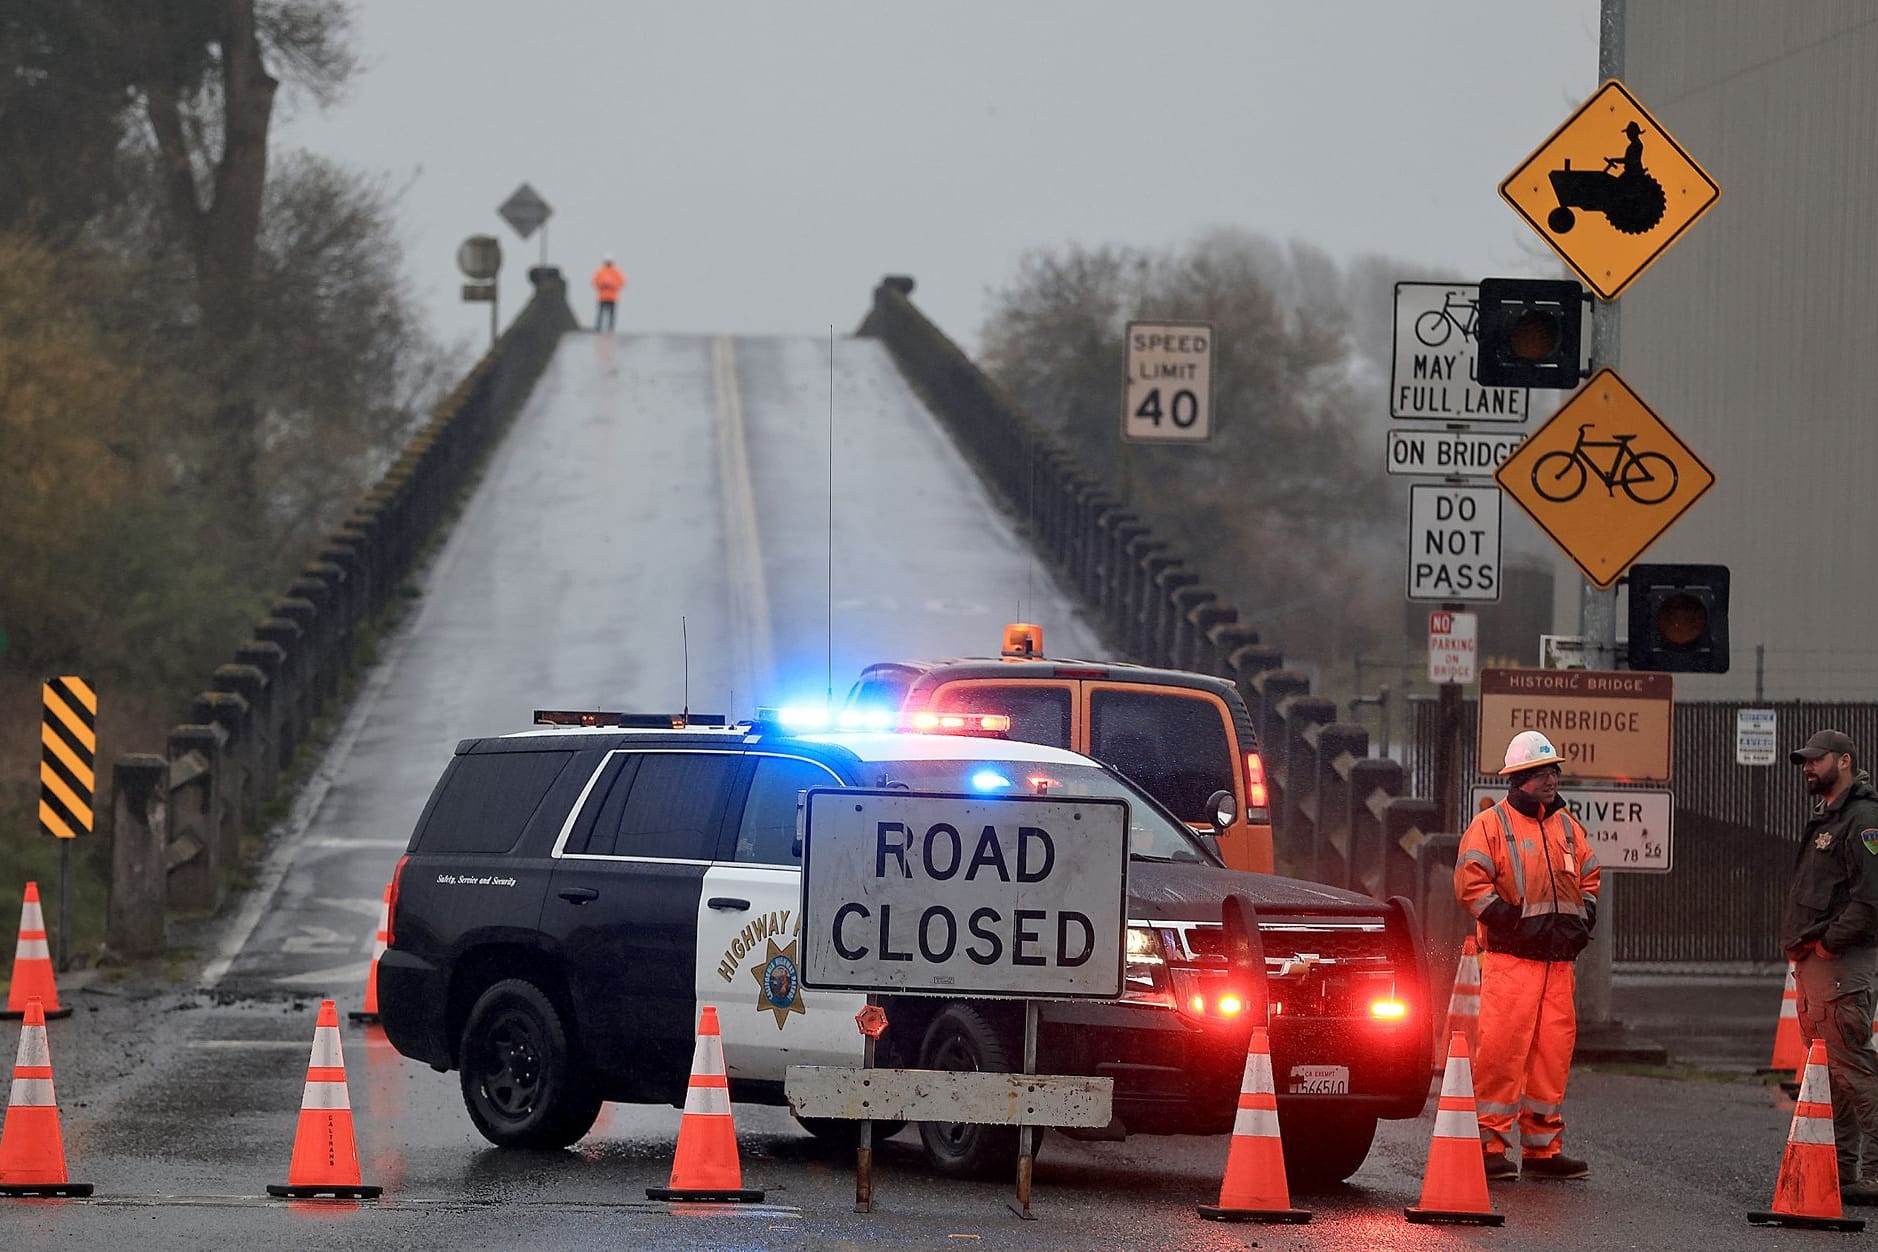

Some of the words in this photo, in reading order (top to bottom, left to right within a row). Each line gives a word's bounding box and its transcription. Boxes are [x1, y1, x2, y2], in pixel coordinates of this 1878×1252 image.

[1133, 333, 1208, 353] SPEED
[1140, 362, 1196, 380] LIMIT
[1413, 354, 1456, 380] MAY
[1135, 387, 1199, 428] 40
[1399, 386, 1453, 413] FULL
[1464, 387, 1520, 415] LANE
[1393, 439, 1425, 466] ON
[1436, 495, 1477, 522] DO
[1425, 529, 1486, 556] NOT
[1415, 563, 1494, 590] PASS
[1432, 615, 1450, 632] NO
[1431, 638, 1474, 651] PARKING
[1433, 665, 1470, 677] BRIDGE
[1445, 654, 1459, 664] ON
[1510, 675, 1578, 689] HISTORIC
[1587, 678, 1643, 692] BRIDGE
[1510, 708, 1640, 733] FERNBRIDGE
[1561, 742, 1596, 764] 1911
[1569, 800, 1642, 823] RIVER
[875, 821, 1055, 884] ROAD
[1622, 848, 1639, 863] 78
[436, 874, 457, 885] Safety,
[457, 875, 478, 885] Service
[478, 876, 492, 885] and
[491, 876, 517, 888] Security
[716, 910, 791, 983] HIGHWAY
[831, 902, 1096, 969] CLOSED
